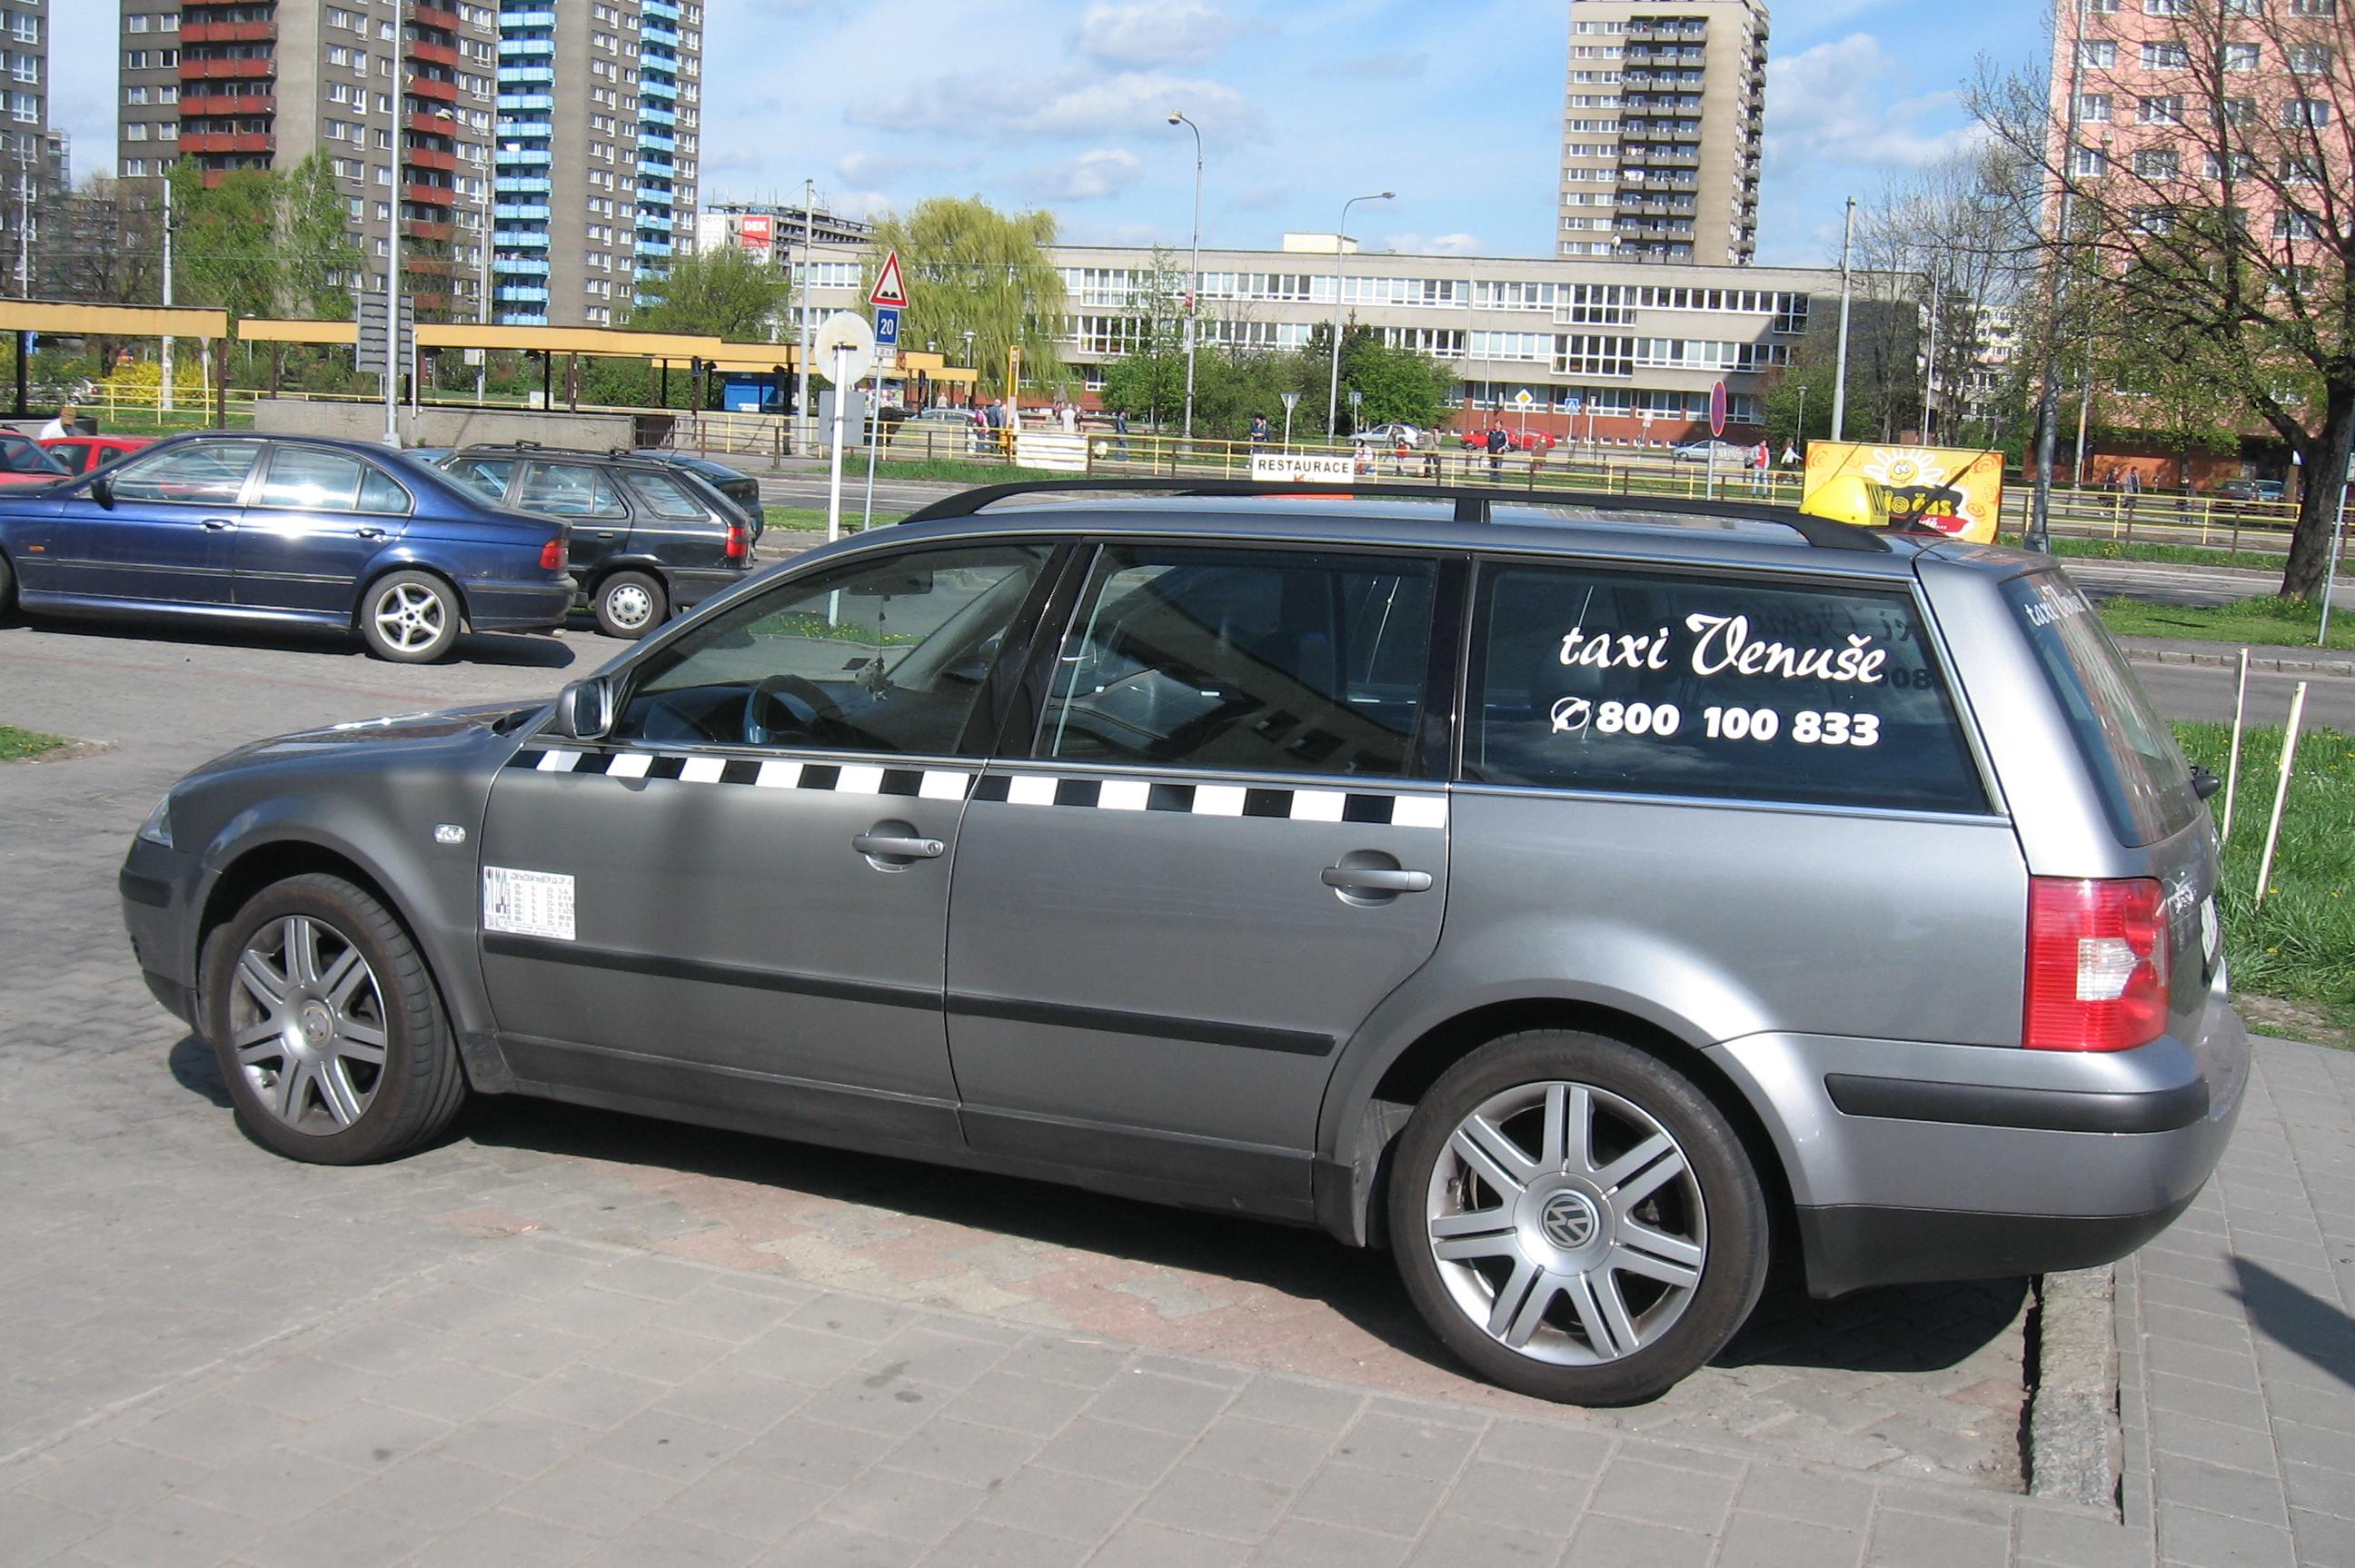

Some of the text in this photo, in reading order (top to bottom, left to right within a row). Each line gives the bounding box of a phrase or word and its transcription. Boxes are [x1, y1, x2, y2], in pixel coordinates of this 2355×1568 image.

[744, 221, 767, 232] DEK
[879, 318, 894, 335] 20
[1258, 459, 1349, 473] RESTAURACE
[1560, 627, 1669, 670] taxi
[1685, 613, 1886, 683] Venuše
[1596, 701, 1880, 746] 800 100 833
